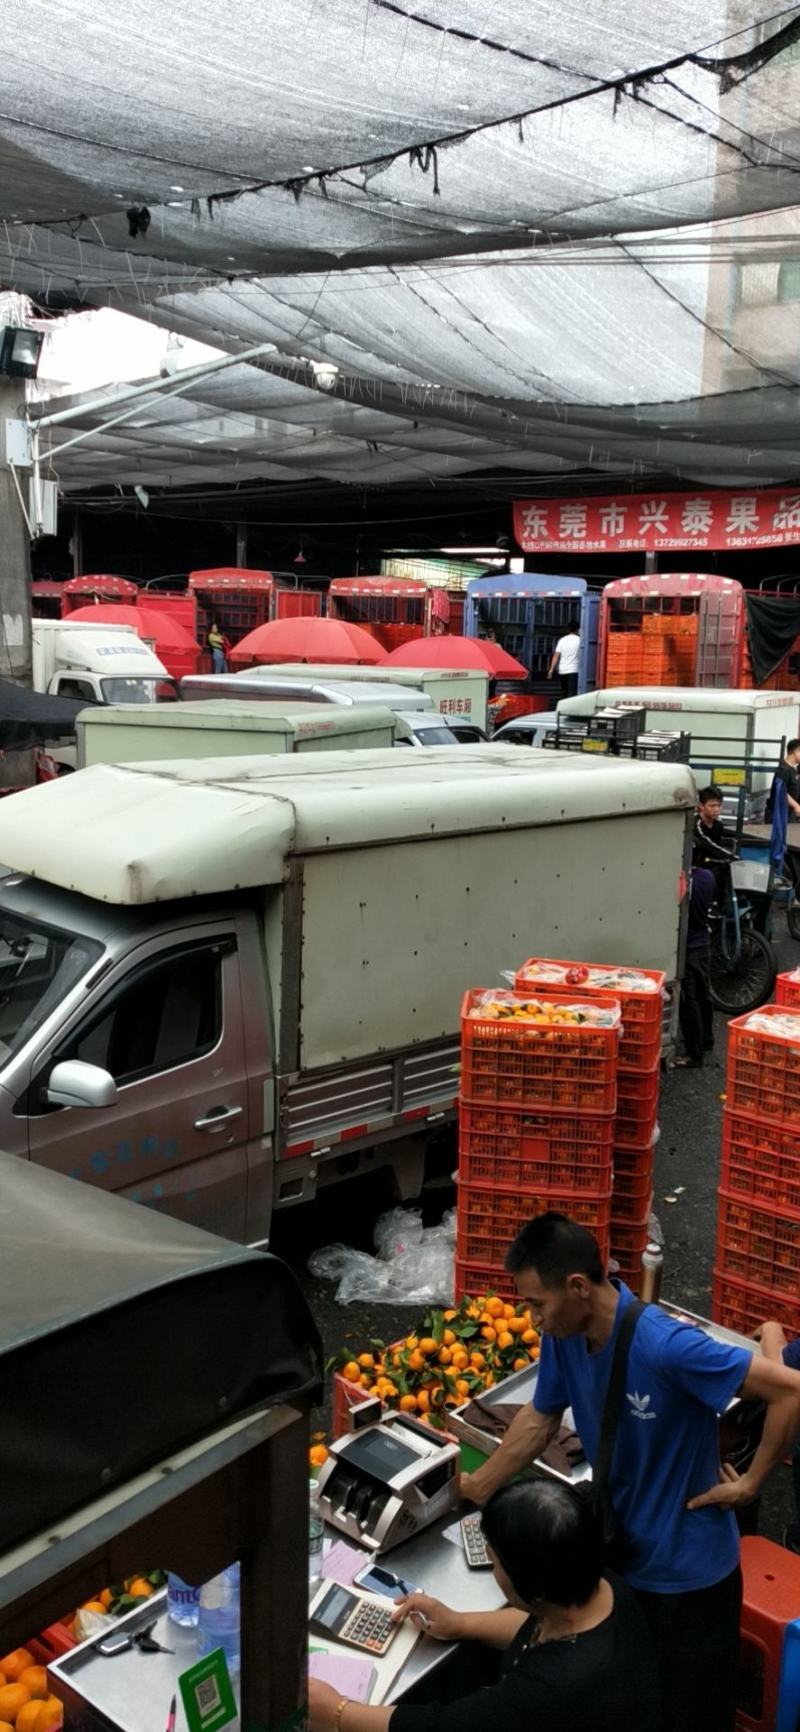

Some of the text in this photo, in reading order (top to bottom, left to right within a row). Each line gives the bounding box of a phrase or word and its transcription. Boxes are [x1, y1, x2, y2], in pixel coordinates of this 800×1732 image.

[522, 495, 800, 539] 东莞市兴泰果品
